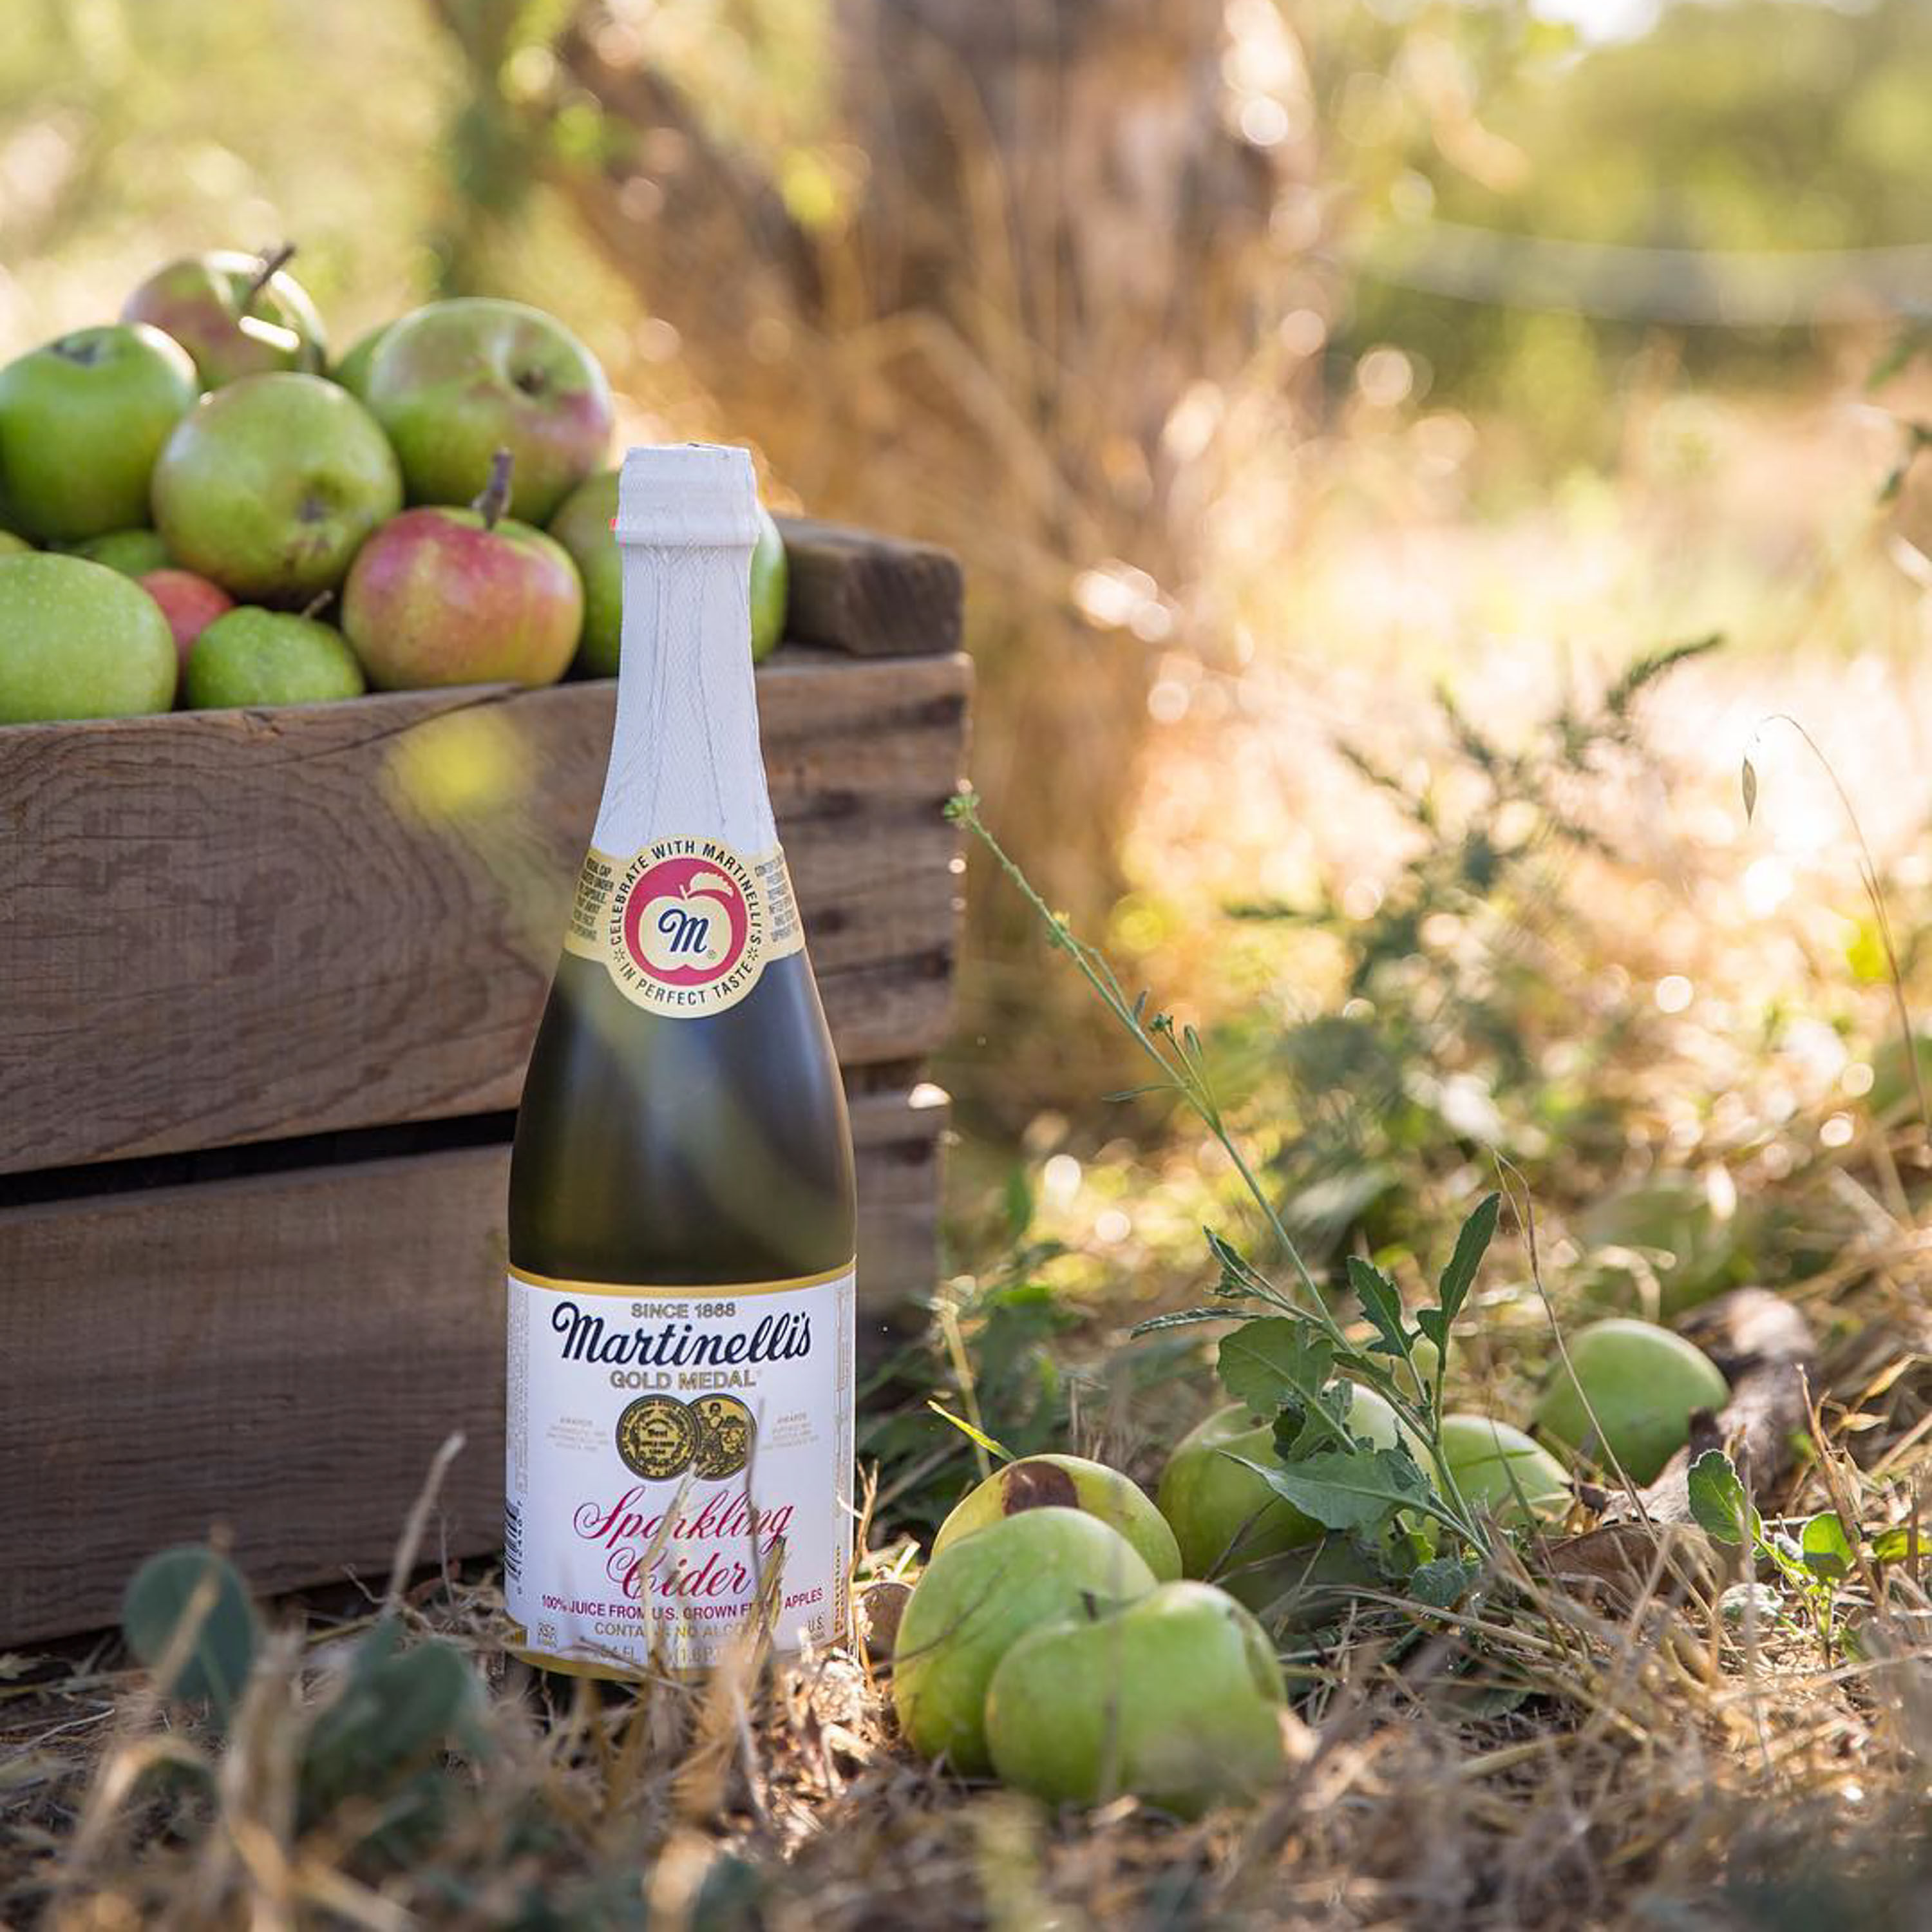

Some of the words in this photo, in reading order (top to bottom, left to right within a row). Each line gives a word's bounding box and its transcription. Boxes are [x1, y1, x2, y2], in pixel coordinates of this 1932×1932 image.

[611, 855, 650, 945] CELEBRATE
[651, 840, 695, 860] WITH
[702, 842, 762, 945] MARTINELLI'S
[619, 962, 636, 981] IN
[635, 979, 706, 1006] PERFECT
[713, 961, 753, 999] TASTE
[630, 1303, 689, 1319] SINCE
[694, 1302, 736, 1318] 1868
[551, 1301, 811, 1366] Martinelli's
[610, 1370, 672, 1390] GOLD
[678, 1369, 757, 1390] MEDAL
[606, 1547, 753, 1600] Cider
[542, 1594, 568, 1612] 100%
[569, 1600, 606, 1616] JUICE
[609, 1604, 645, 1621] FROM
[683, 1604, 737, 1620] GROWN
[784, 1586, 824, 1610] APPLES
